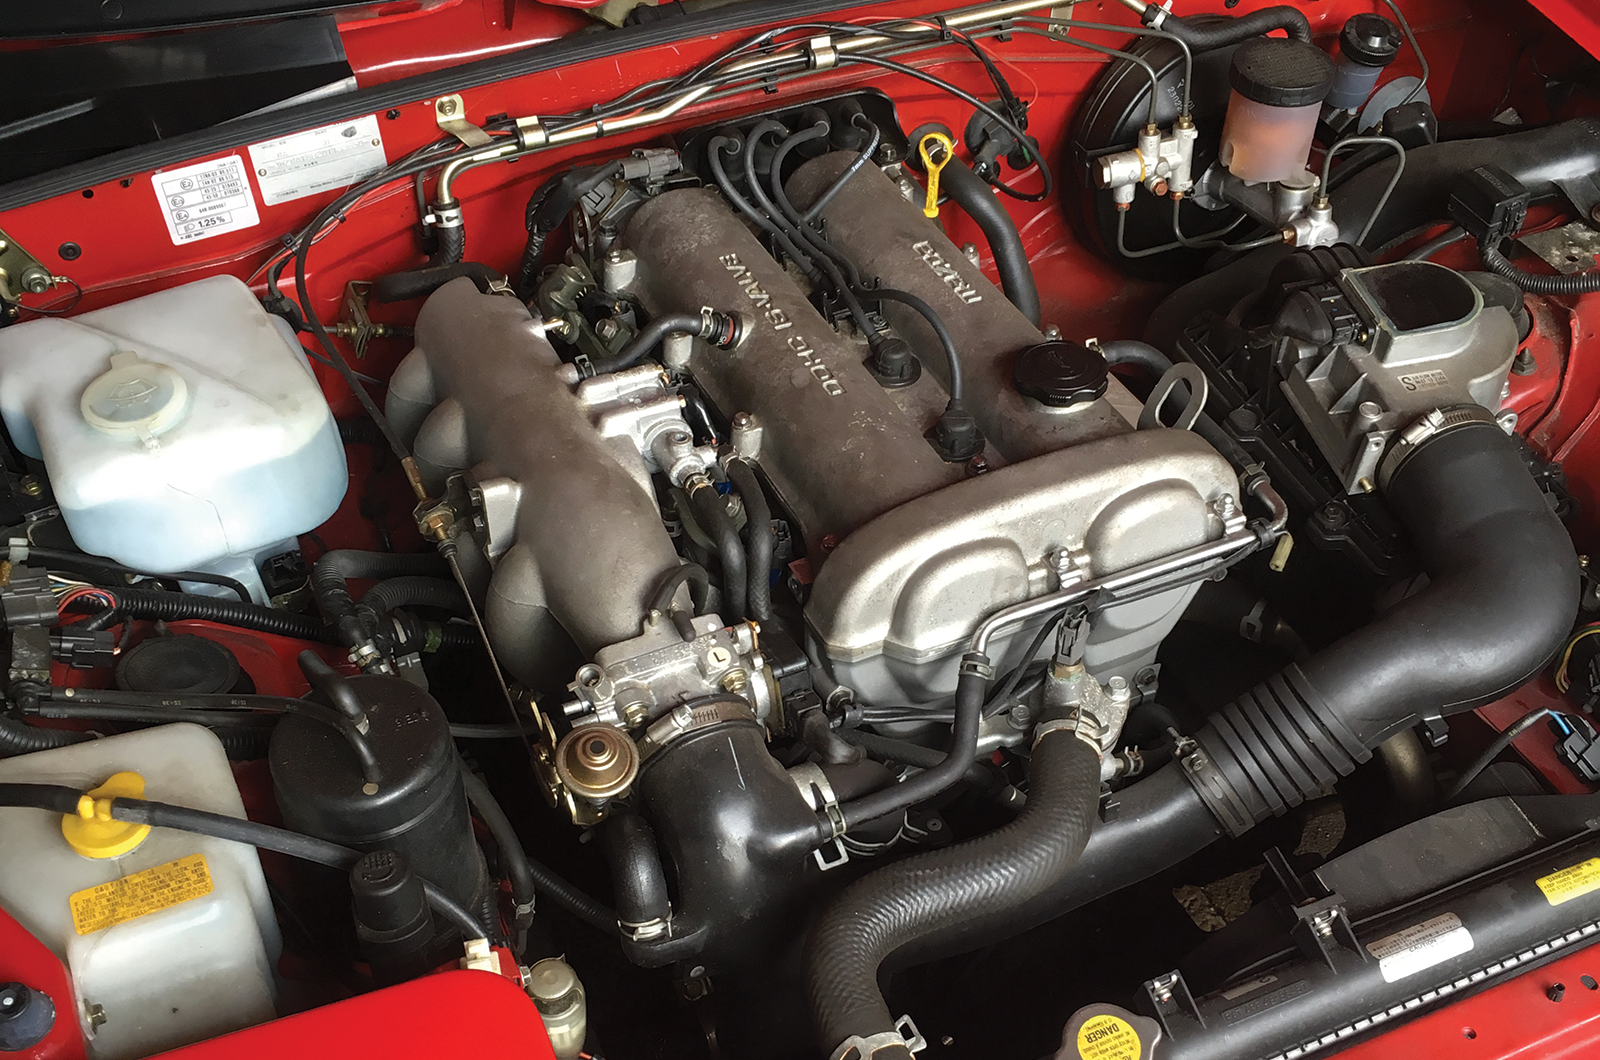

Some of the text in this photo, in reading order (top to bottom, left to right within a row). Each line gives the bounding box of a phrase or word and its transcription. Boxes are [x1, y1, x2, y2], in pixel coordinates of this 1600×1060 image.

[198, 218, 217, 228] 1.25
[912, 240, 983, 305] MAZDA
[718, 253, 846, 397] DOHC 16-VALVE
[1401, 376, 1416, 391] S
[1547, 870, 1571, 882] DANGER
[94, 879, 129, 893] CAUTION
[1409, 939, 1437, 952] CAUTION
[1084, 1023, 1120, 1044] DANGER
